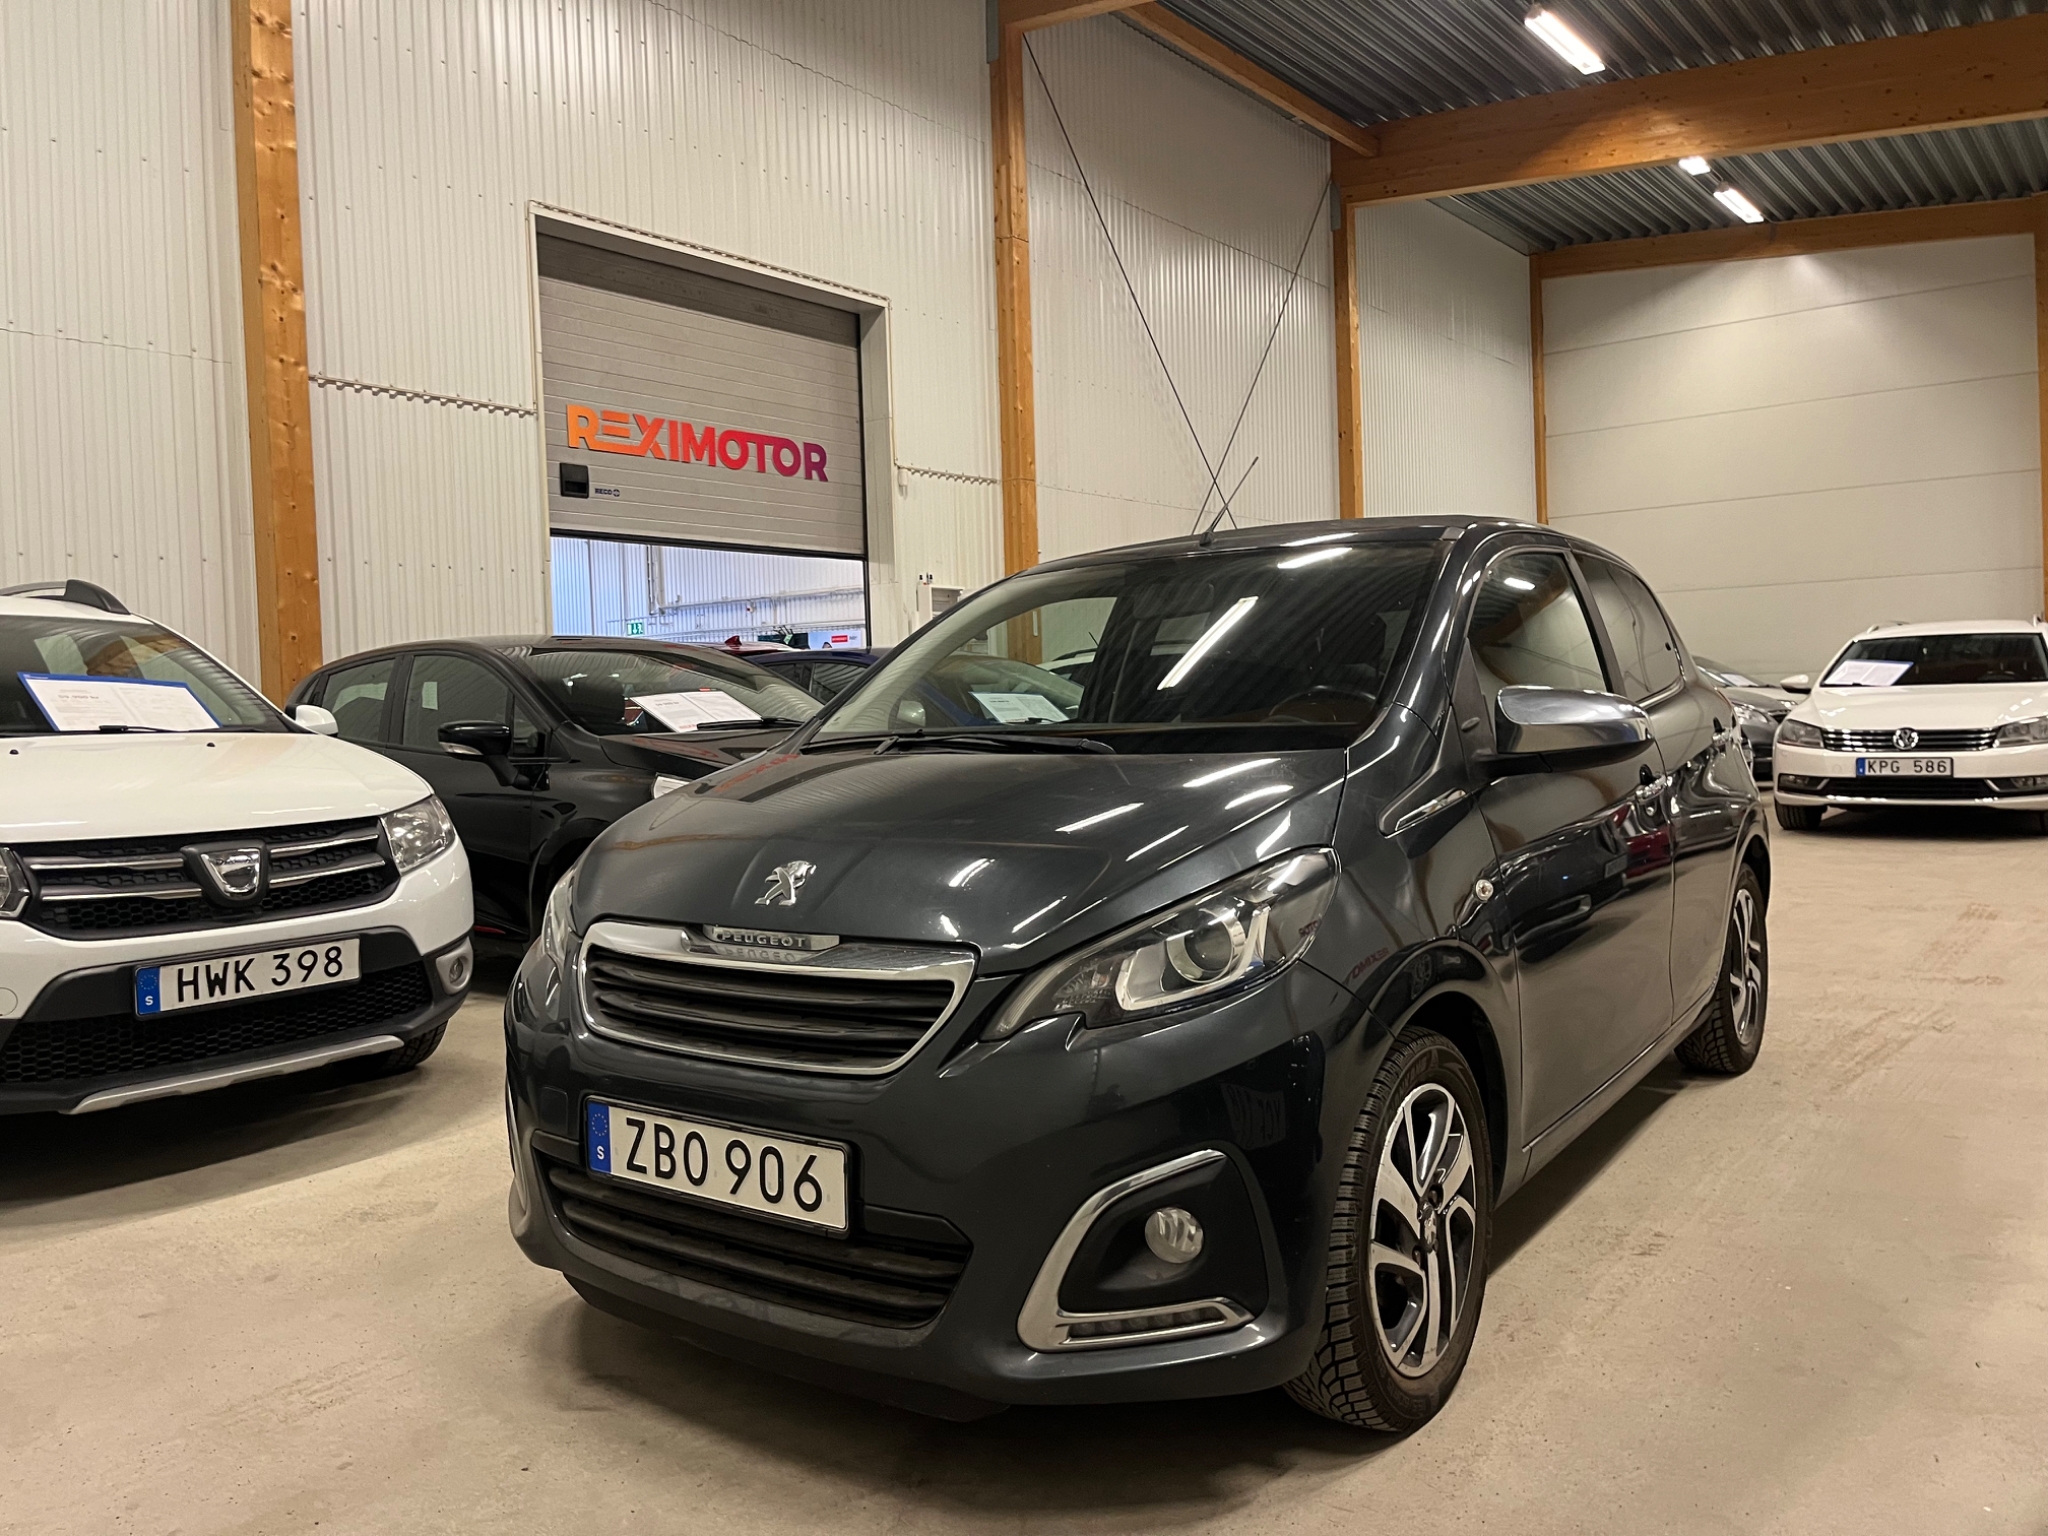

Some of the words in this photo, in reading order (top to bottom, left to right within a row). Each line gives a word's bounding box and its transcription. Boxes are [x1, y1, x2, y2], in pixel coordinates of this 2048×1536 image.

[566, 404, 828, 482] REXIMOTOR
[1867, 760, 1900, 774] KPG
[1913, 760, 1947, 774] 586
[721, 930, 806, 948] PEUGEOT
[177, 958, 255, 1003] HWK
[271, 946, 343, 987] 398
[145, 995, 154, 1006] S
[596, 1145, 605, 1160] S
[626, 1117, 709, 1187] ZBO
[725, 1139, 823, 1212] 906
